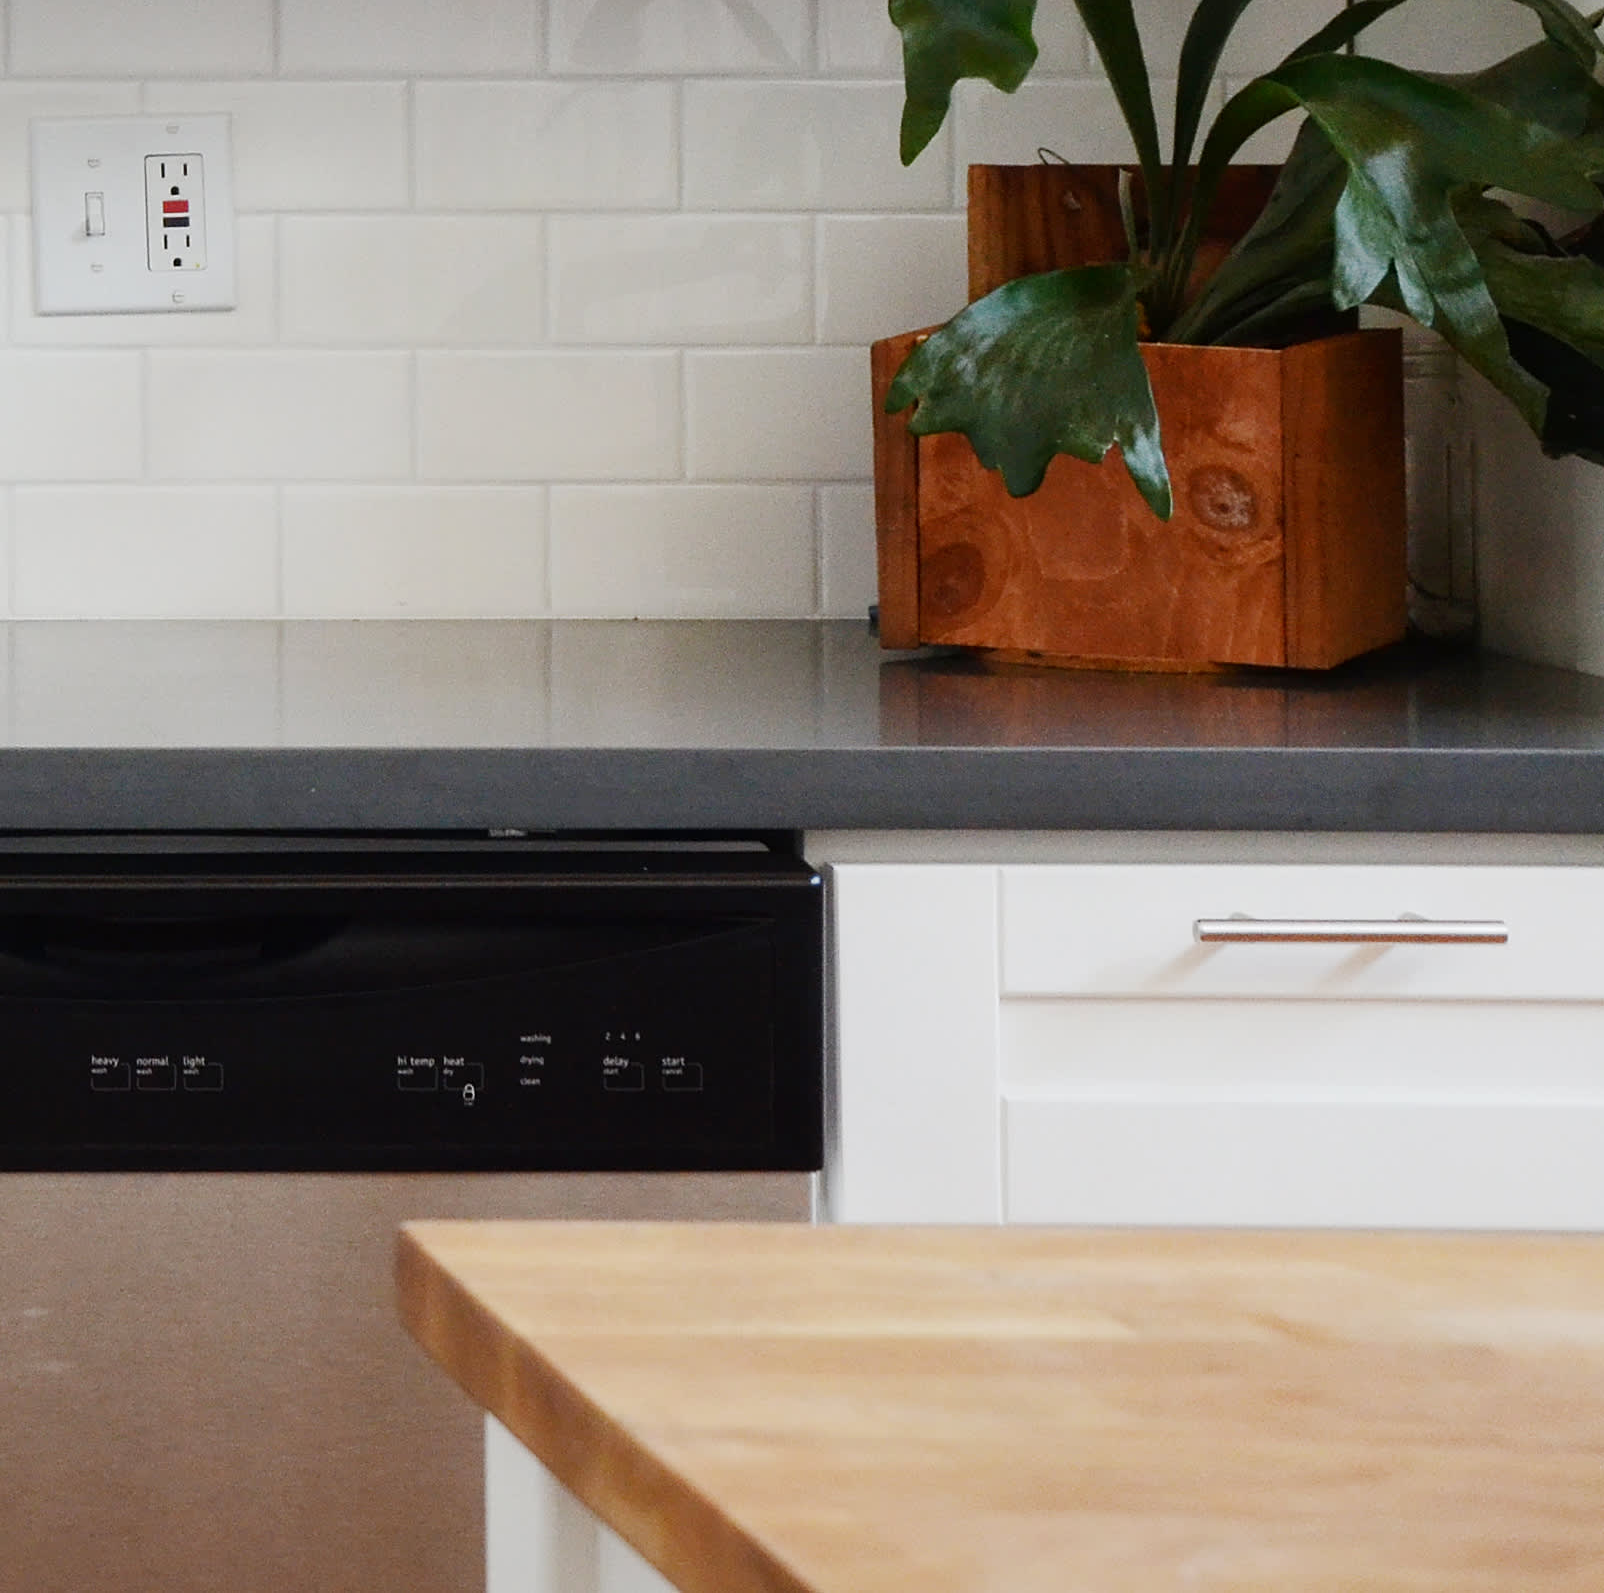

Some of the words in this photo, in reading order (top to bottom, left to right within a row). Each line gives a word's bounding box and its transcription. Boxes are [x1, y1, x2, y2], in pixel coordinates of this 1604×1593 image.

[520, 1033, 551, 1044] washing
[91, 1055, 119, 1068] heavy
[136, 1056, 169, 1066] normal
[183, 1056, 206, 1068] light
[397, 1056, 408, 1066] hi
[410, 1056, 435, 1068] temp
[443, 1056, 465, 1066] heat
[519, 1056, 544, 1066] drying
[603, 1056, 629, 1068] delay
[662, 1057, 685, 1067] start
